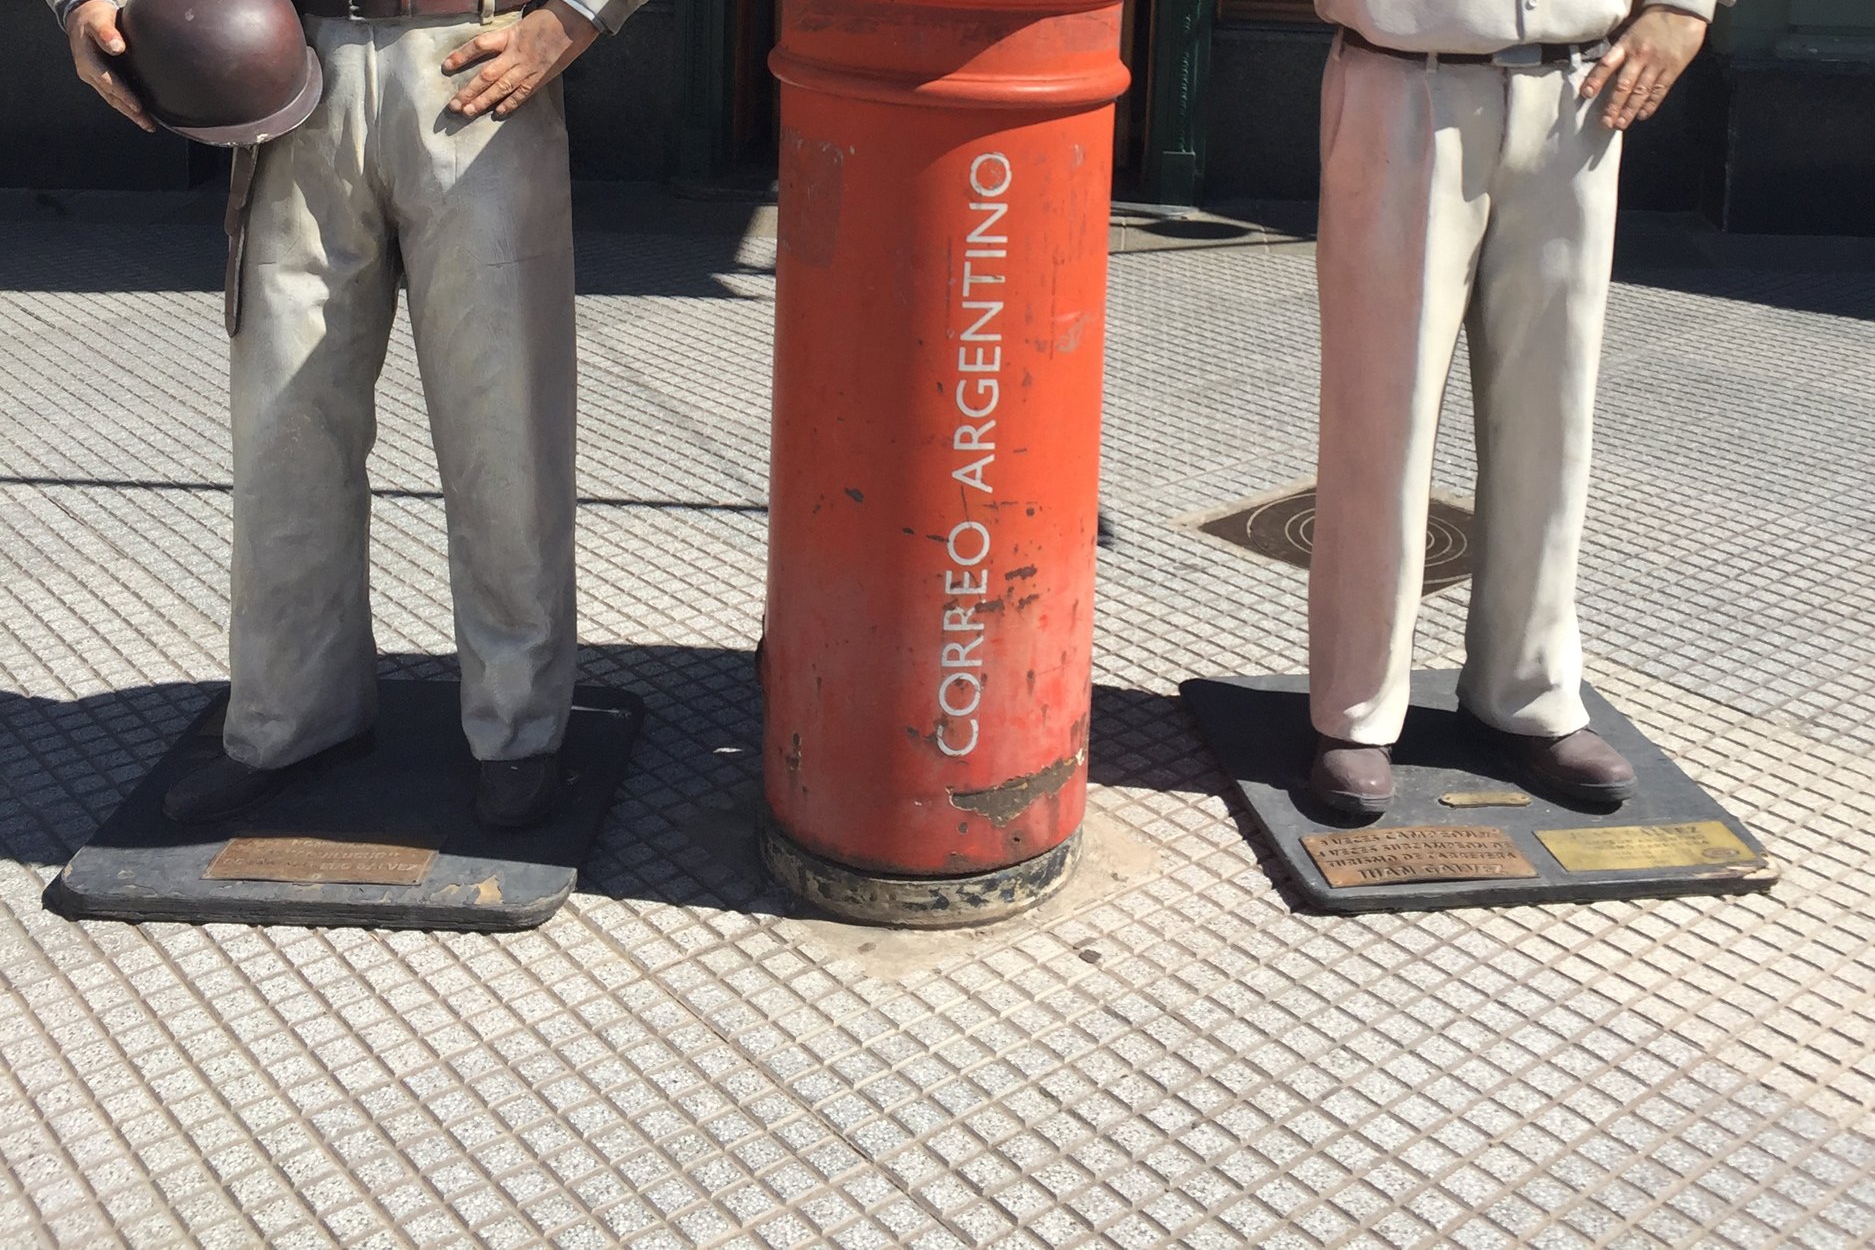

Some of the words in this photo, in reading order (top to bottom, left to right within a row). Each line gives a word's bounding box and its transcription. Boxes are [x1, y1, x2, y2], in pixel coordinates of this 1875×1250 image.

[951, 151, 1012, 494] ARGENTINO
[936, 521, 991, 758] CORREO
[1324, 854, 1399, 868] TURISMO
[1357, 864, 1417, 880] JUAN
